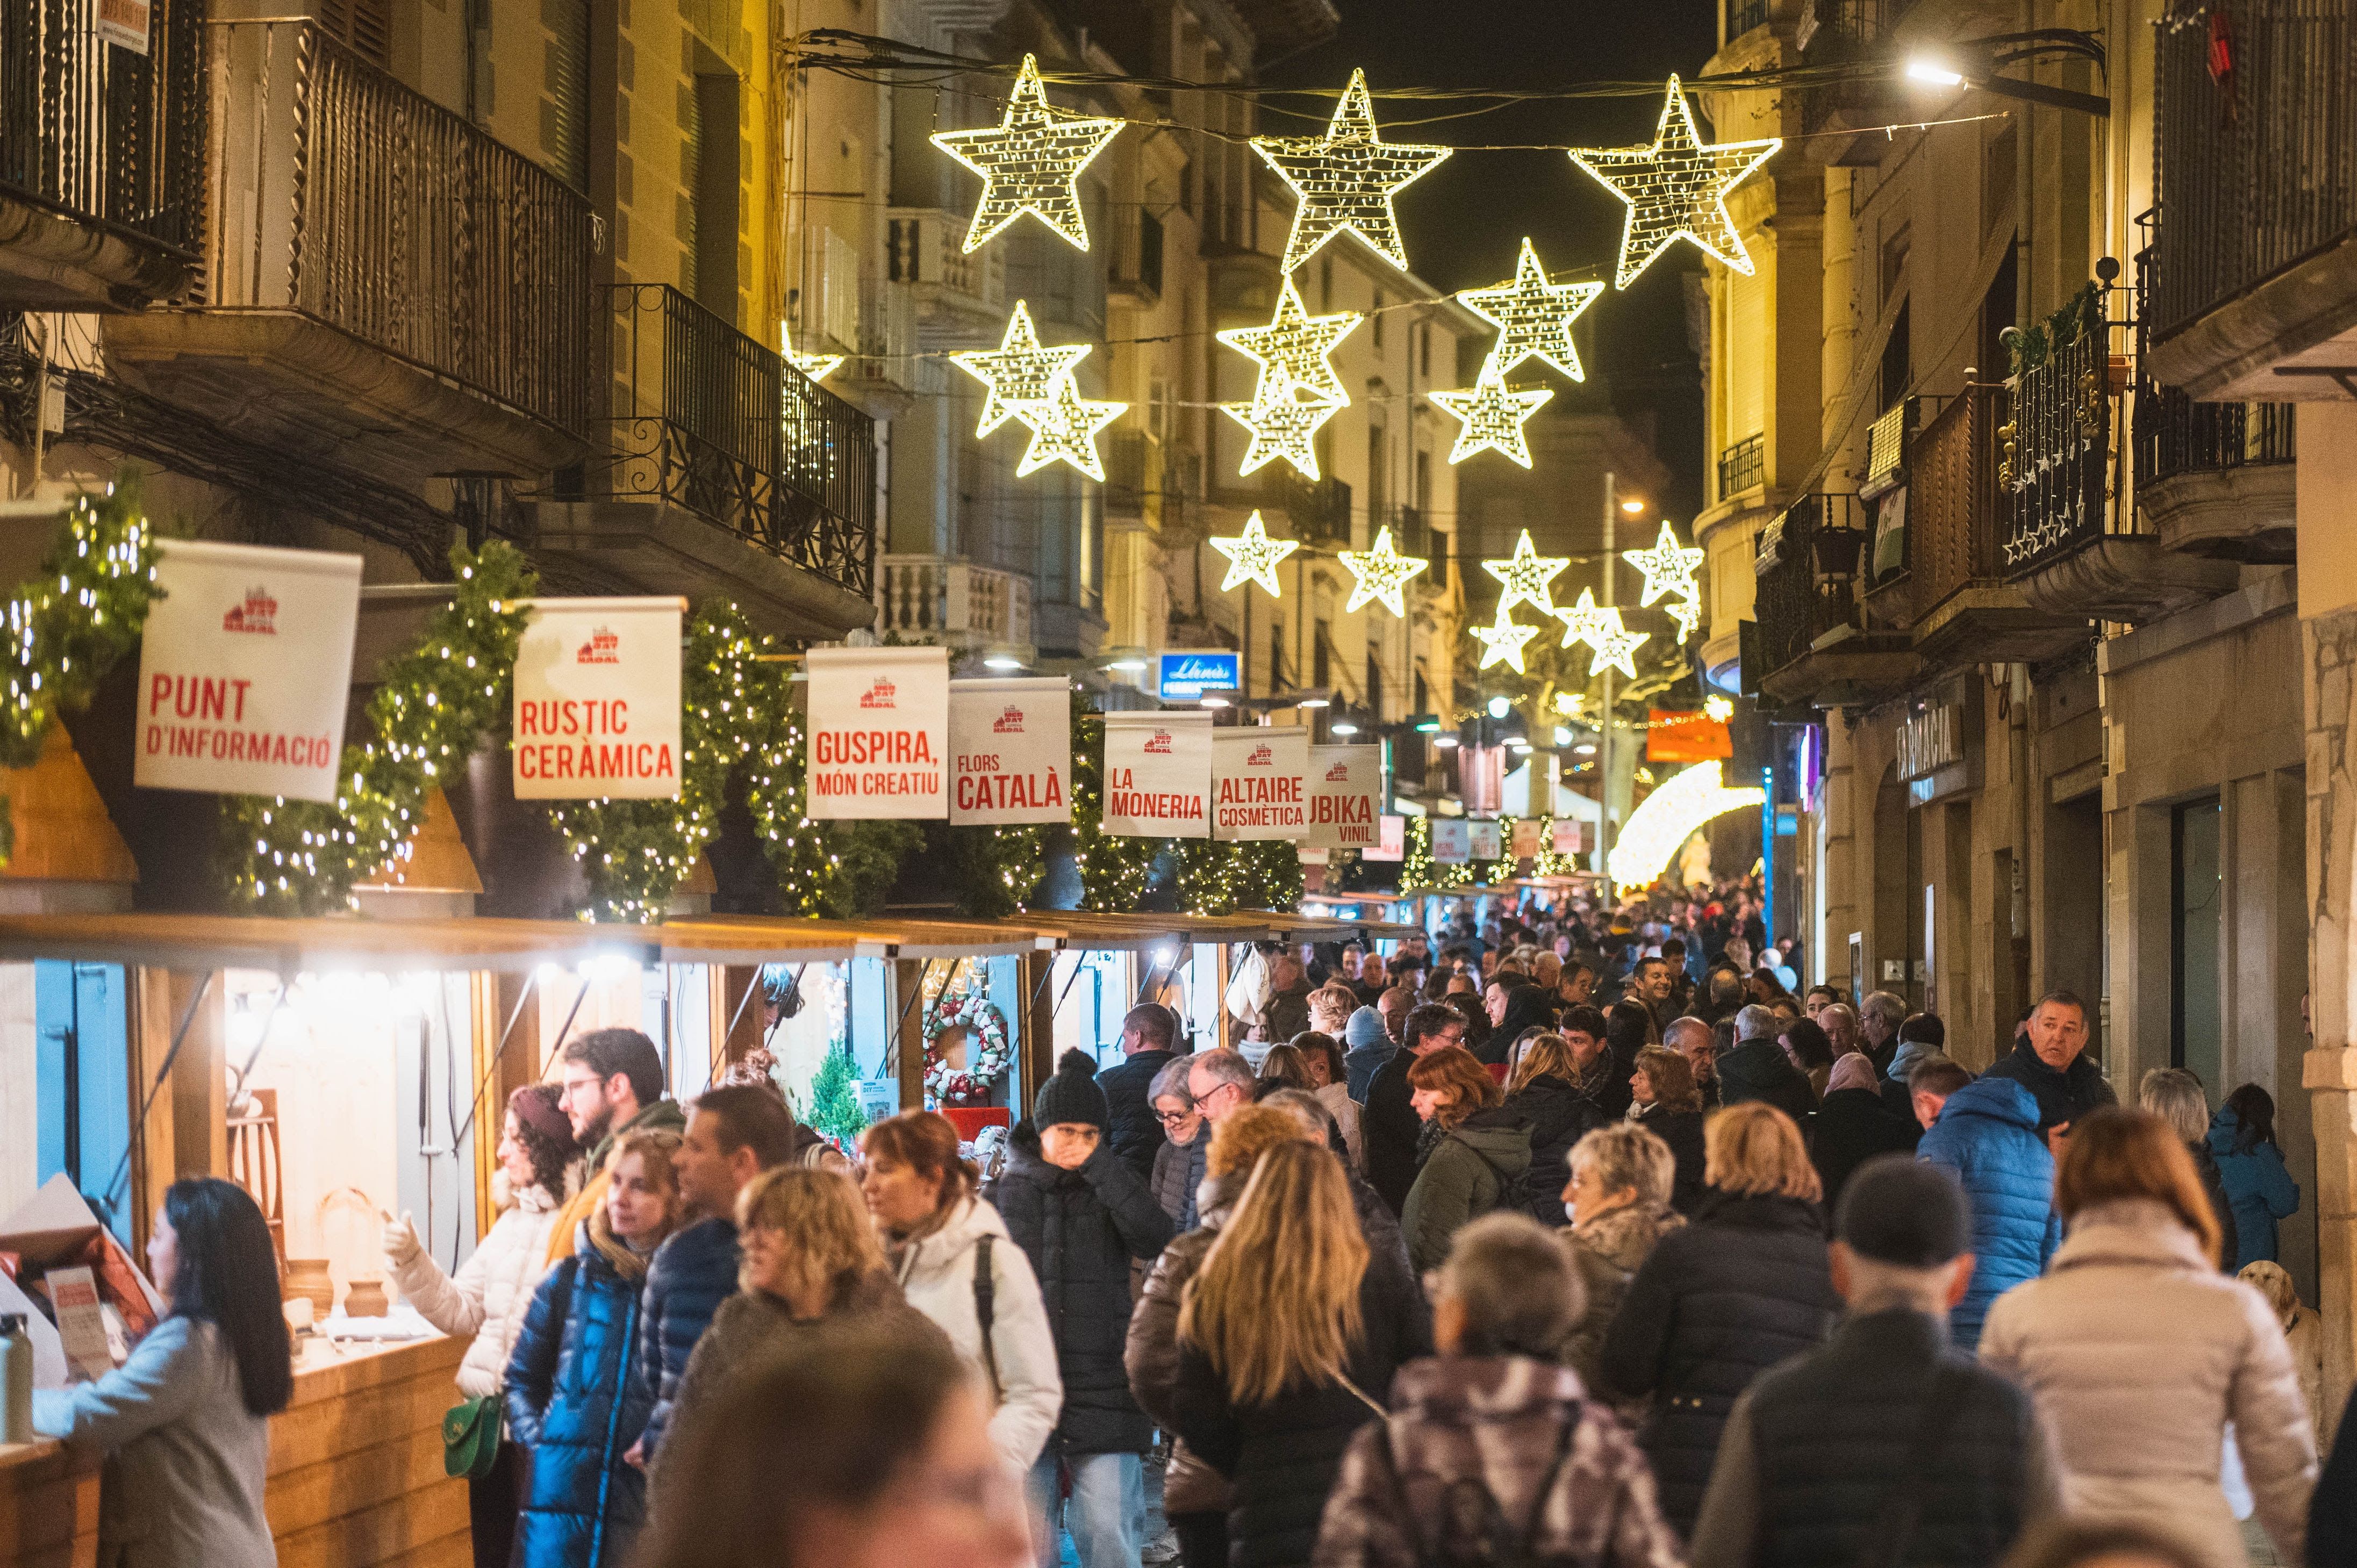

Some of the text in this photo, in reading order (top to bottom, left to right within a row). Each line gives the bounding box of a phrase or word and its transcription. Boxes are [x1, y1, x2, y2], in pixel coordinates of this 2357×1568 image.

[150, 674, 251, 722] PUNT
[520, 700, 628, 735] RUSTIC
[146, 726, 331, 769] D'INFORMACIÓ
[519, 738, 673, 779] CERÀMICA
[816, 731, 938, 767] GUSPIRA,
[957, 754, 1000, 772] FLORS
[816, 769, 938, 796] MÓN CREATIU
[957, 766, 1063, 811] CATALÀ
[1112, 768, 1133, 789] LA
[1219, 777, 1303, 804] ALTAIRE
[1111, 792, 1203, 820] MONERIA
[1219, 805, 1304, 827] COSMÈTICA
[1338, 826, 1372, 842] VINIL
